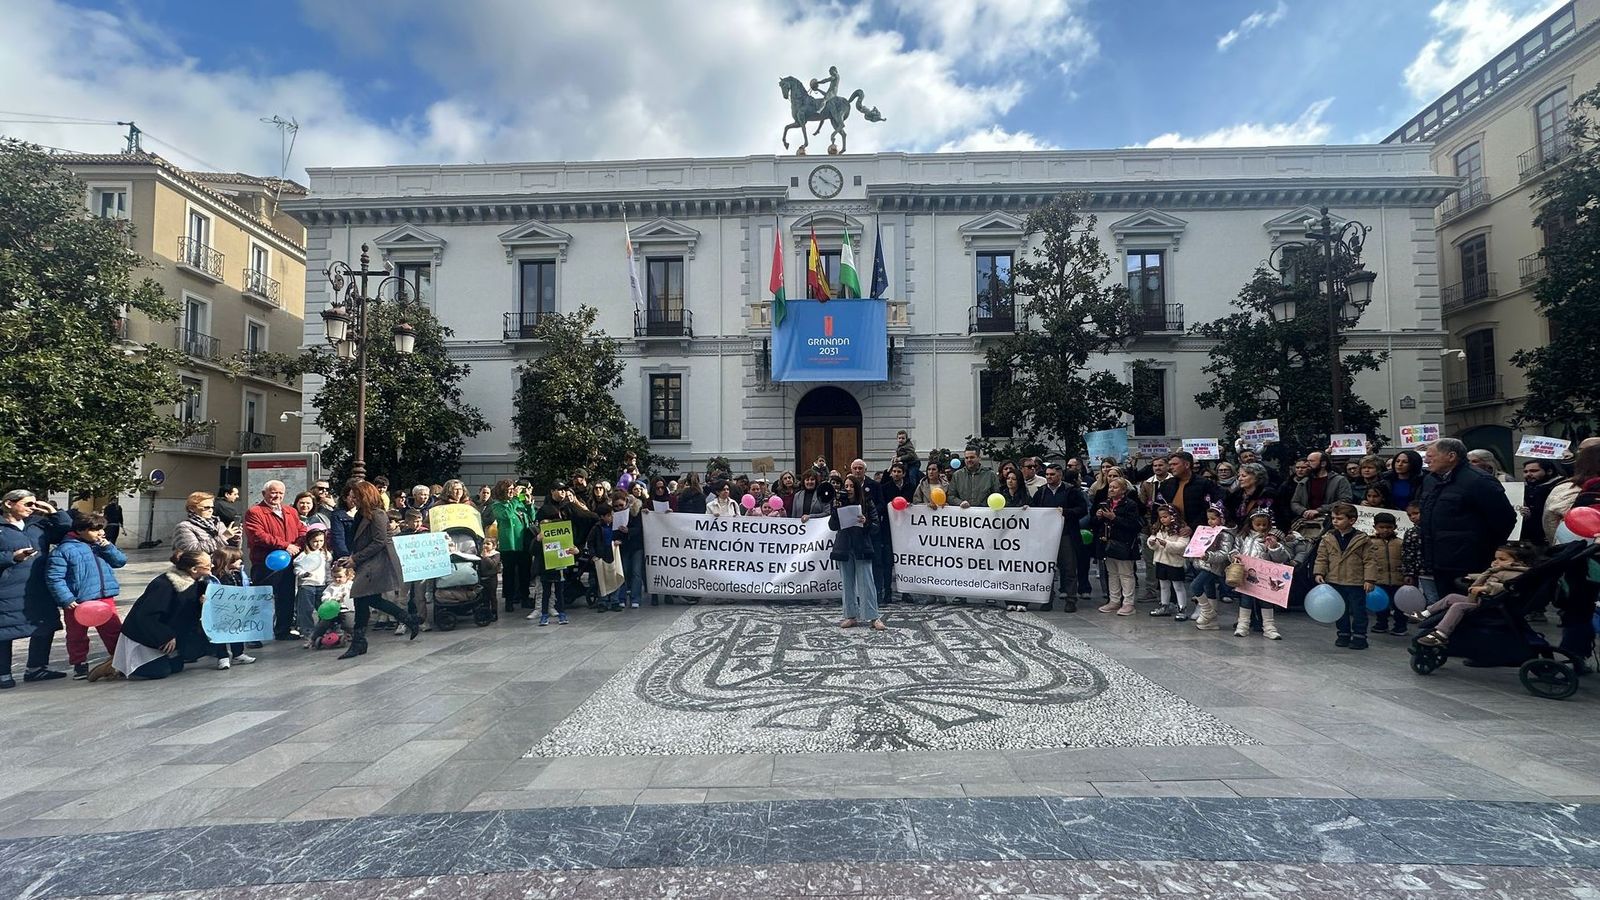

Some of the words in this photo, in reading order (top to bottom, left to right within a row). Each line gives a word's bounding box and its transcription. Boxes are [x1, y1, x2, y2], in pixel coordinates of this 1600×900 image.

[807, 337, 850, 346] GRANADA
[819, 347, 838, 355] 2031
[695, 518, 728, 533] MÁS
[732, 521, 806, 536] RECURSOS
[911, 514, 927, 526] LA
[932, 515, 1030, 530] REUBICACIÓN
[544, 527, 570, 537] GEMA
[662, 536, 679, 549] EN
[684, 538, 754, 553] ATENCIÓN
[759, 539, 834, 554] TEMPRANA
[919, 535, 984, 550] VULNERA
[994, 538, 1021, 551] LOS
[691, 557, 764, 573] BARRERAS
[769, 562, 787, 574] EN
[790, 560, 816, 573] SUS
[968, 558, 994, 571] DEL
[999, 560, 1056, 574] MENOR
[229, 619, 265, 634] QUEDO
